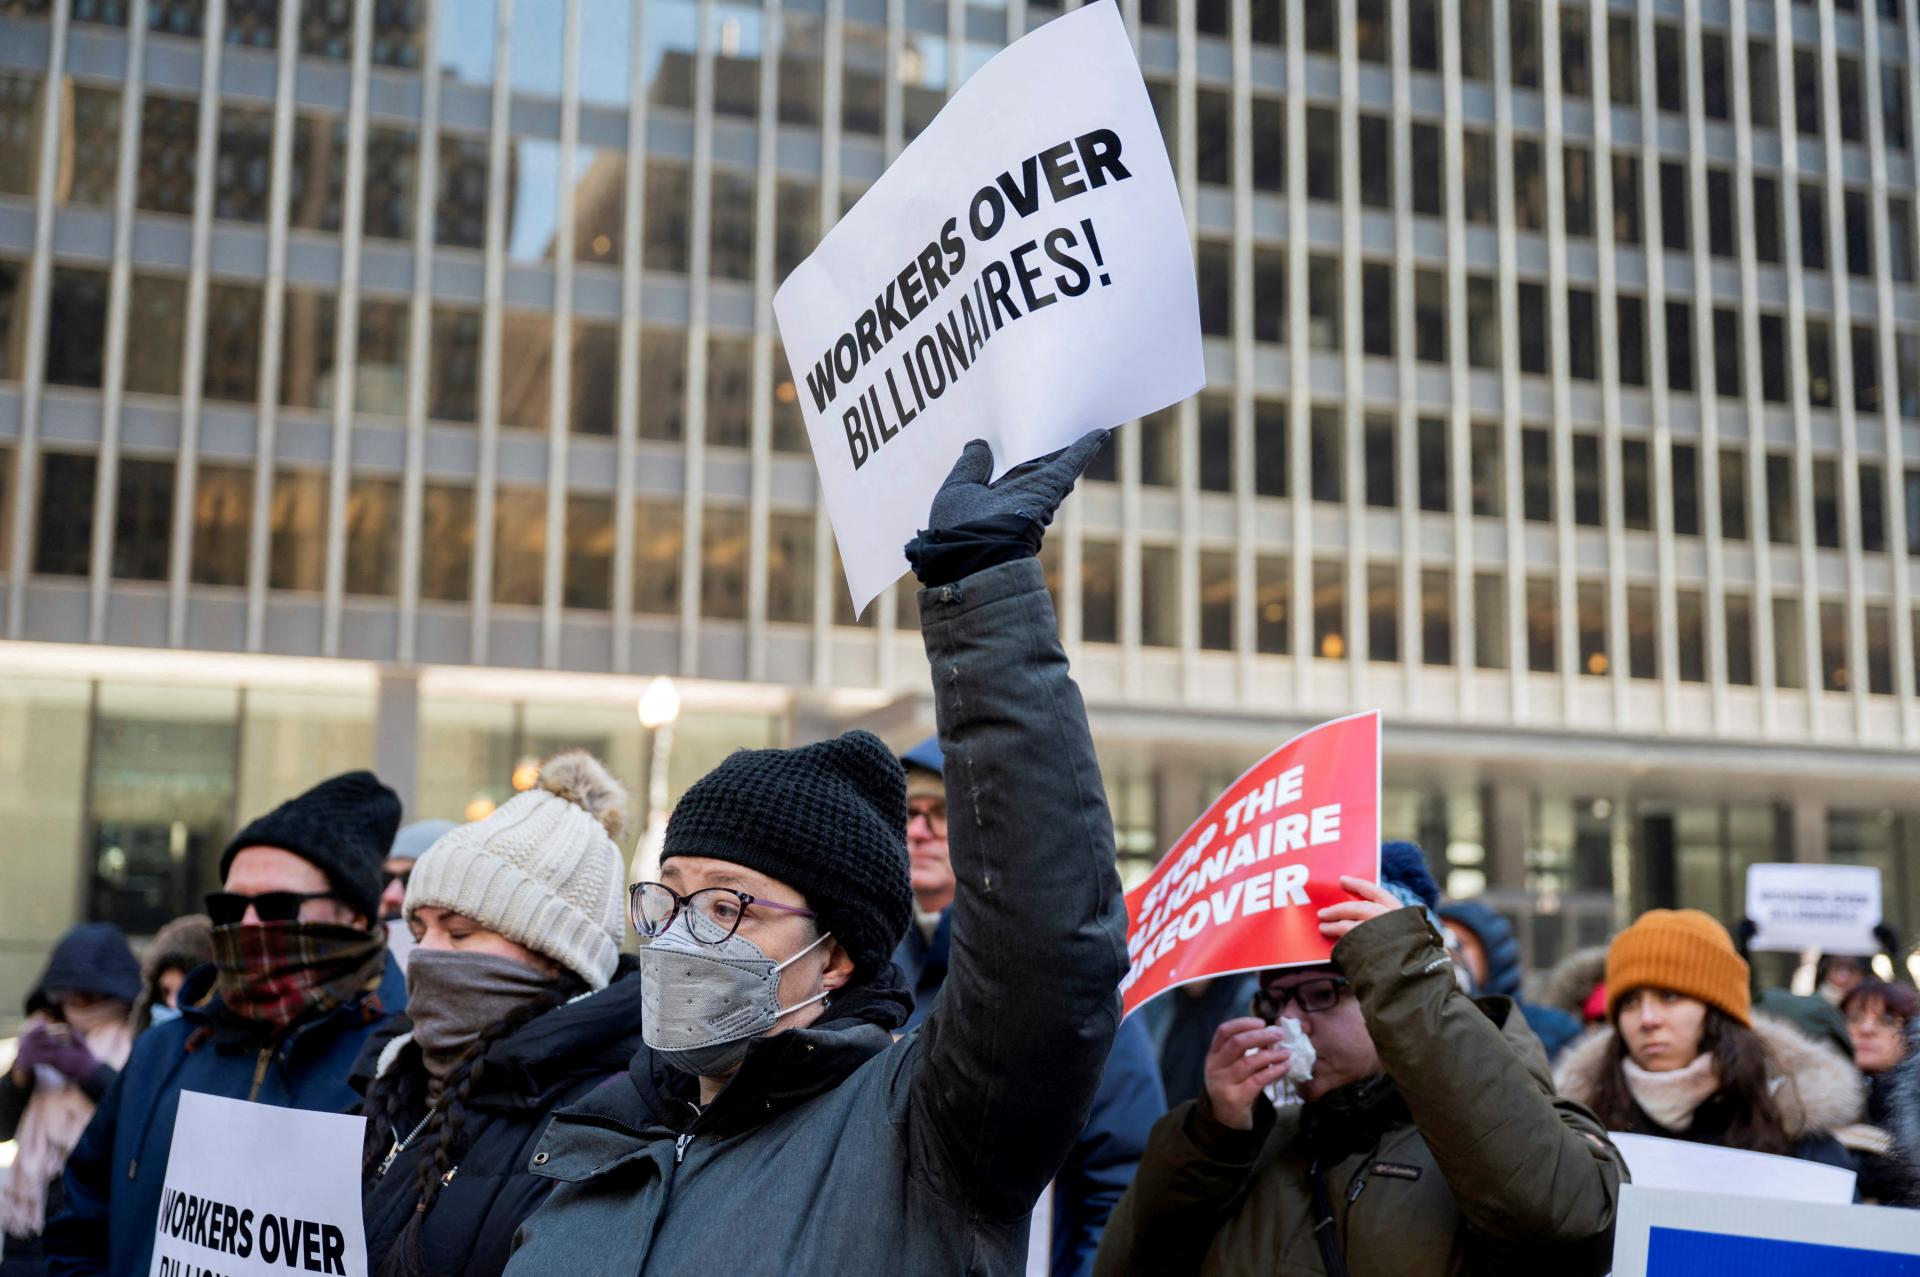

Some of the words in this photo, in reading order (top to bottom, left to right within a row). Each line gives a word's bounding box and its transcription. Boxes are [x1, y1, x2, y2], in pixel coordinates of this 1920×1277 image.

[806, 217, 966, 415] WORKERS
[968, 128, 1132, 242] OVER
[842, 218, 1112, 472] BILLIONAIRES!
[1137, 823, 1218, 923] STOP
[1224, 765, 1305, 836] THE
[160, 1187, 254, 1259] WORKERS
[259, 1213, 346, 1276] OVER
